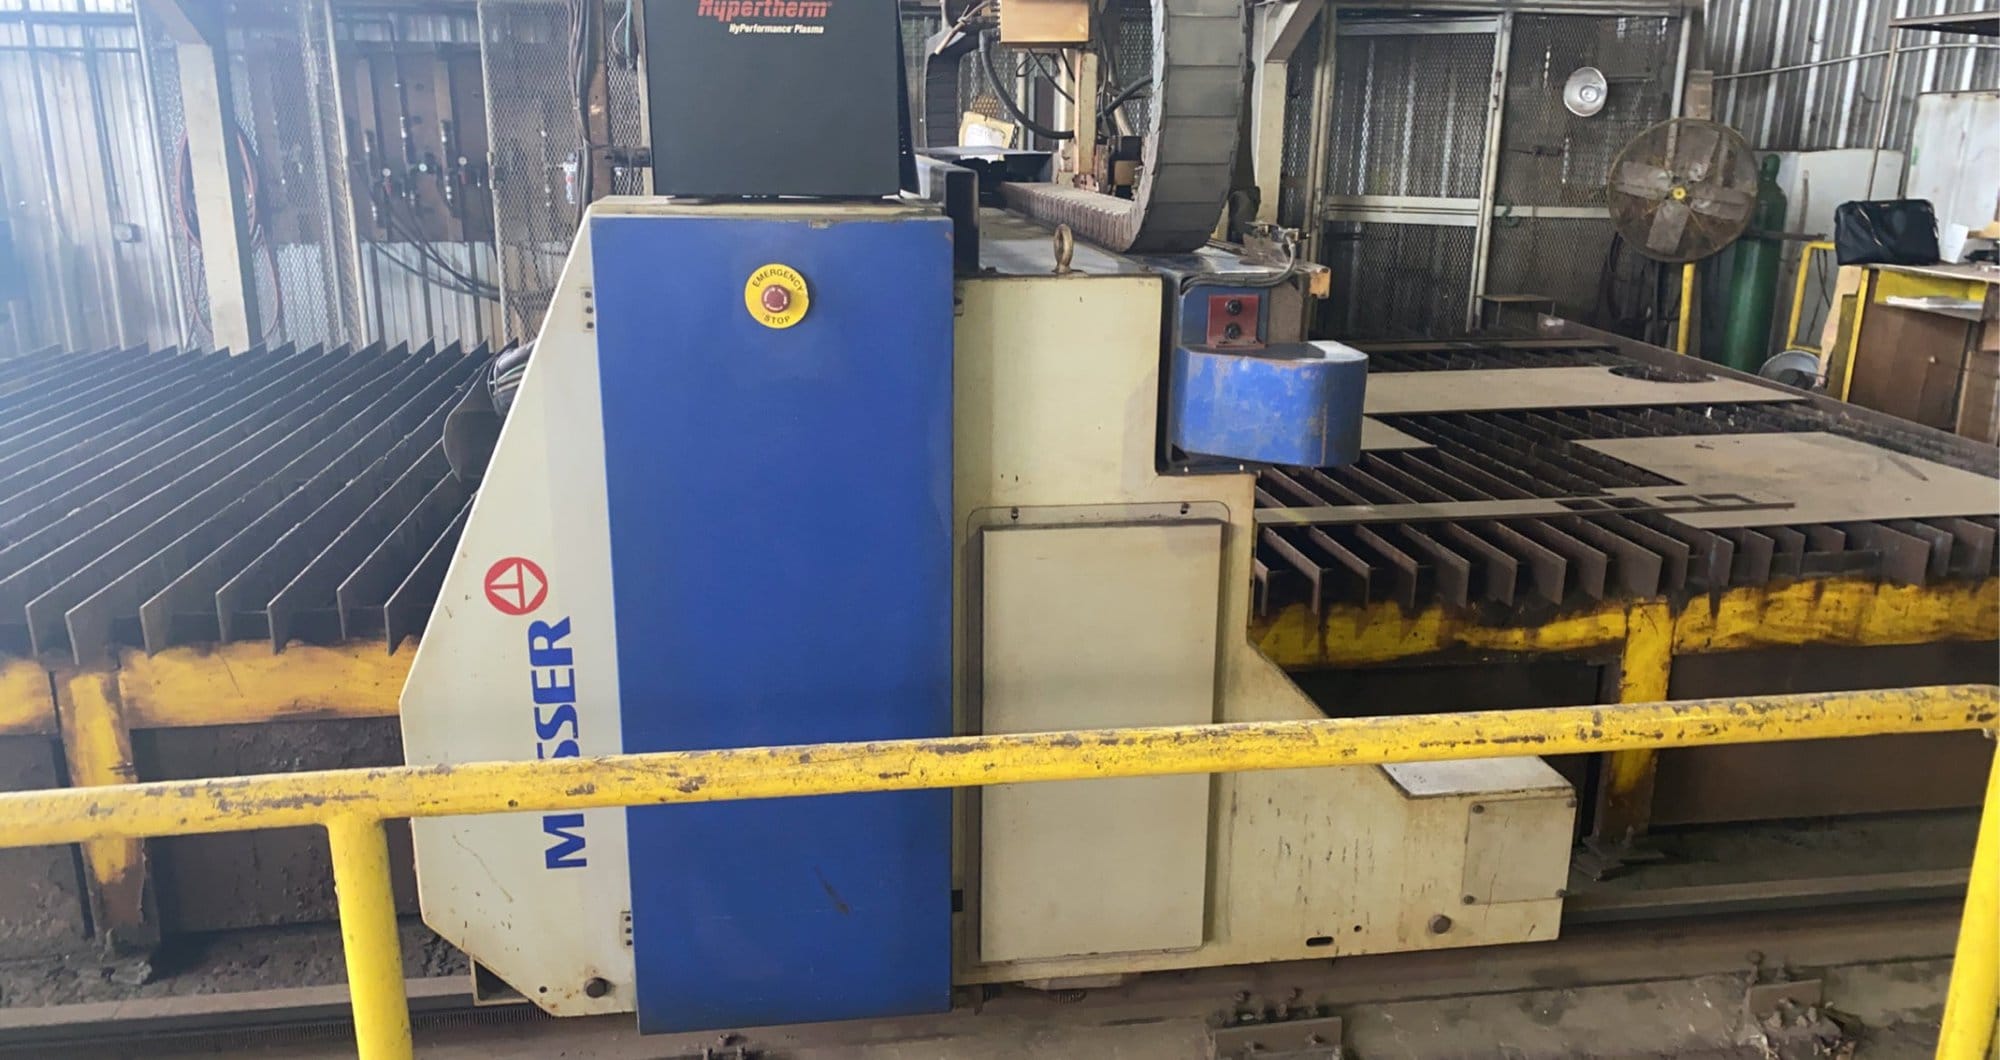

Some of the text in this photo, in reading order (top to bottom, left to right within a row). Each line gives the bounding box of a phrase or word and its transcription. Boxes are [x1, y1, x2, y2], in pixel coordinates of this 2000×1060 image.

[794, 24, 824, 33] Plasma
[752, 268, 803, 291] EMERGENCY
[764, 314, 790, 324] STOP
[528, 616, 588, 869] MSSER
